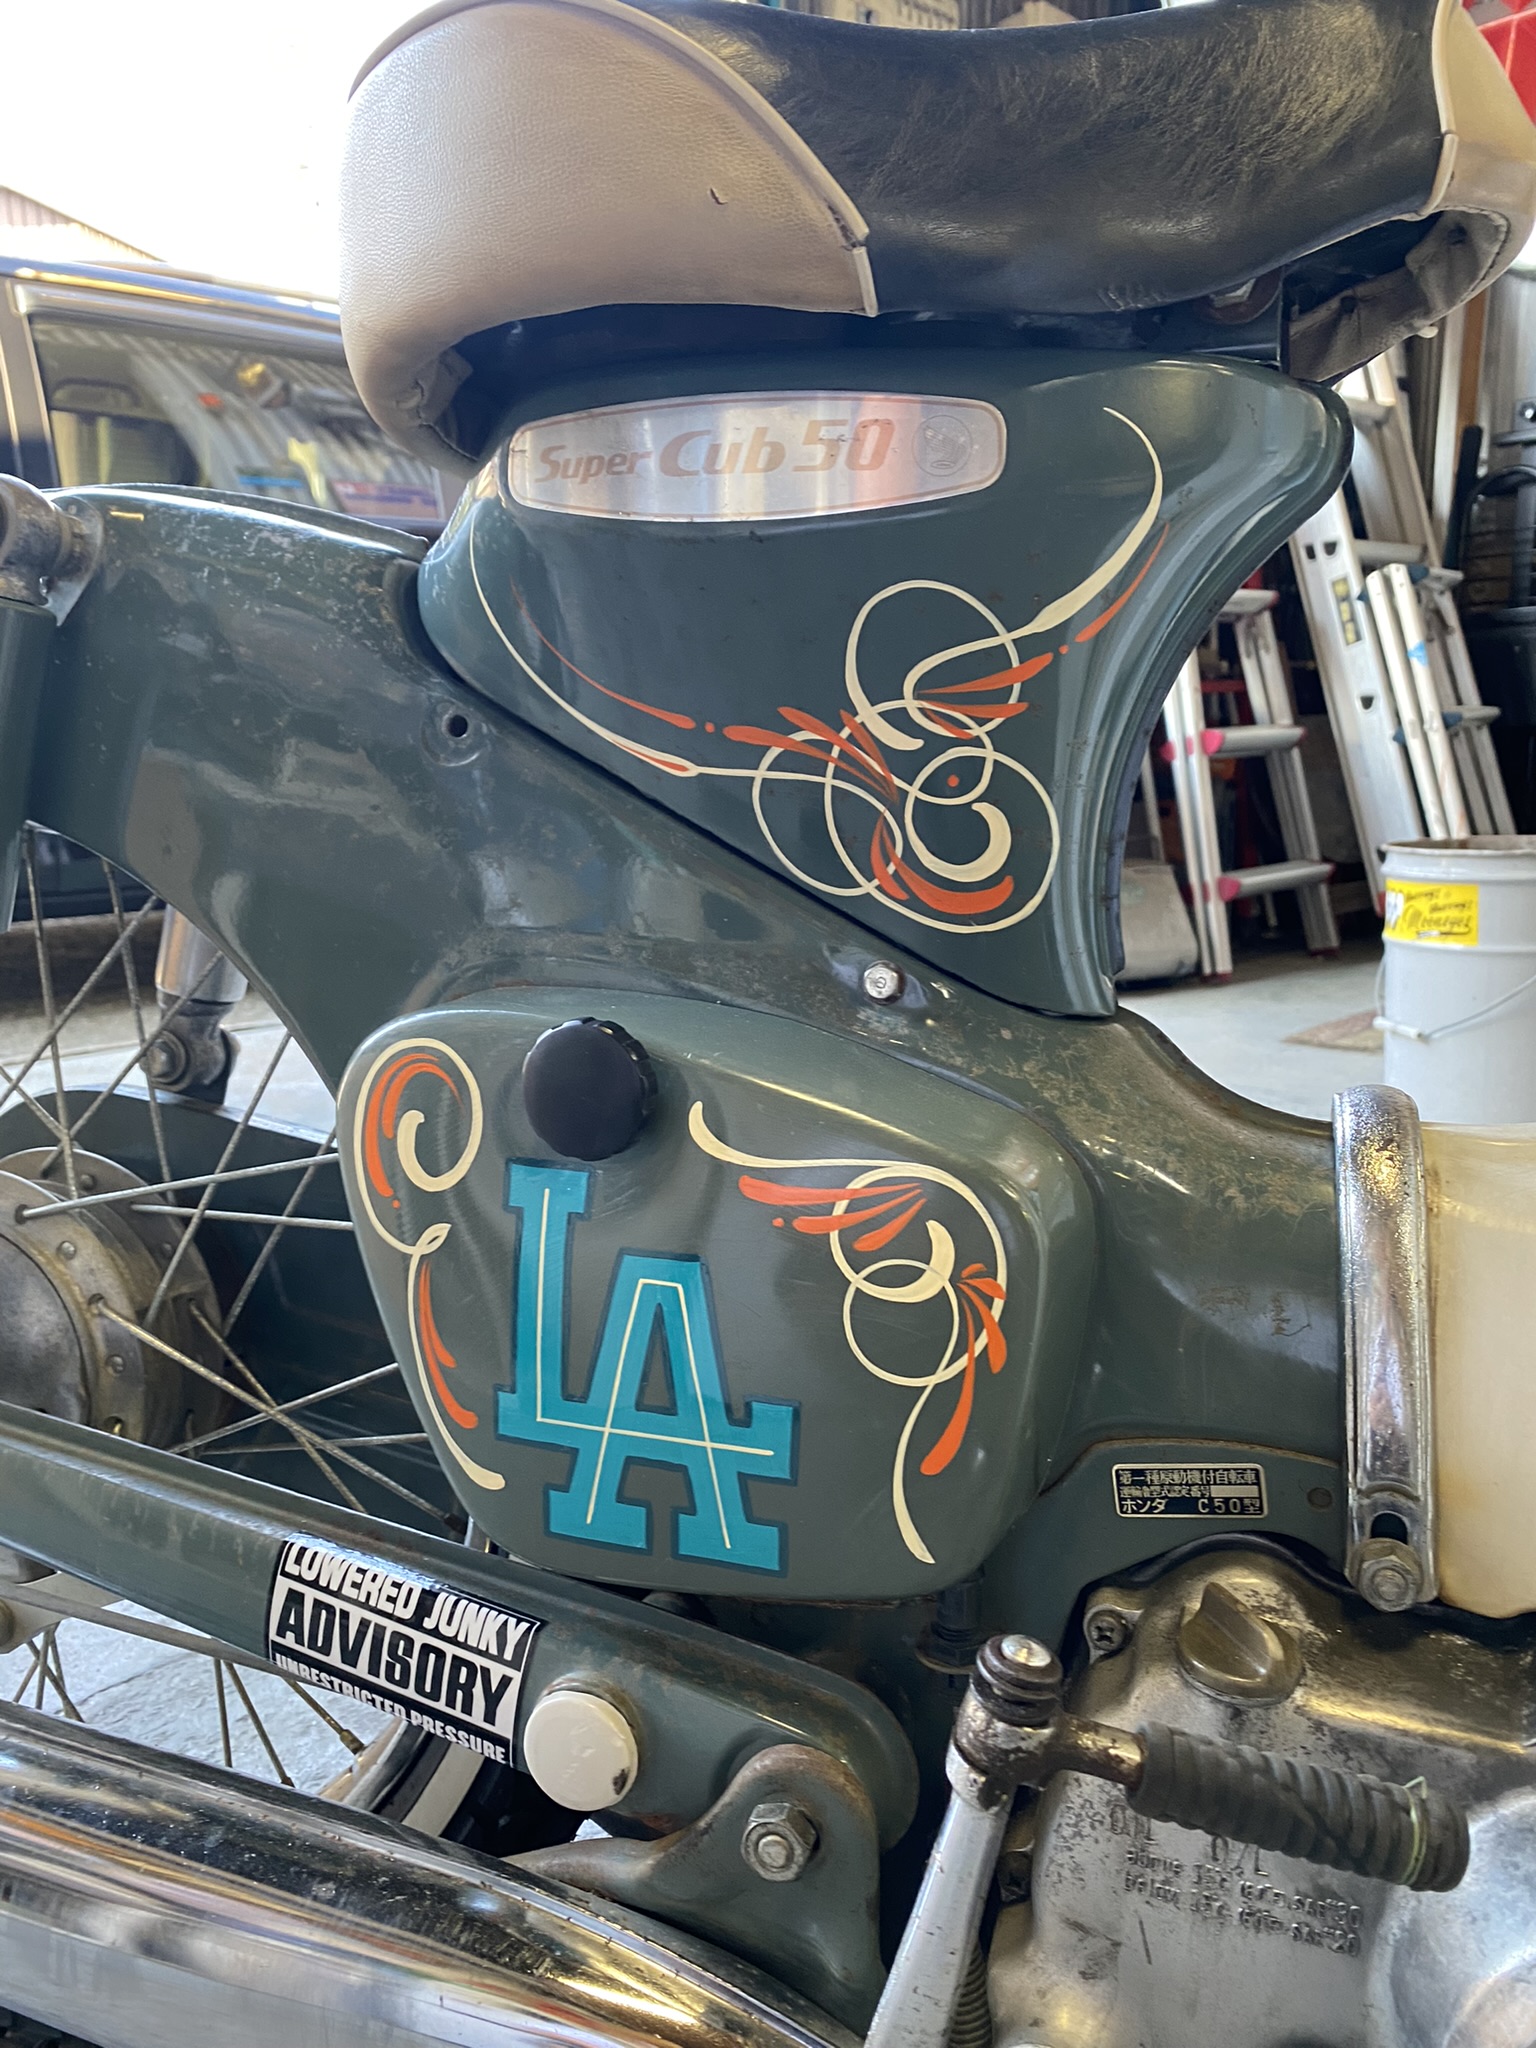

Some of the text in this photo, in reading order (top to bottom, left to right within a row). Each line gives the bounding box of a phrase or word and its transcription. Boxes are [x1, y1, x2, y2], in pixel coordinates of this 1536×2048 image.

[534, 417, 896, 485] Super Cub 50
[494, 1157, 799, 1577] LA
[1119, 1469, 1257, 1484] 第一種原動機付自転車
[1121, 1498, 1168, 1514] ホンダ
[284, 1540, 531, 1662] LOWERED JUNKY
[275, 1587, 514, 1727] ADVISORY
[409, 1708, 507, 1765] PRESSURE
